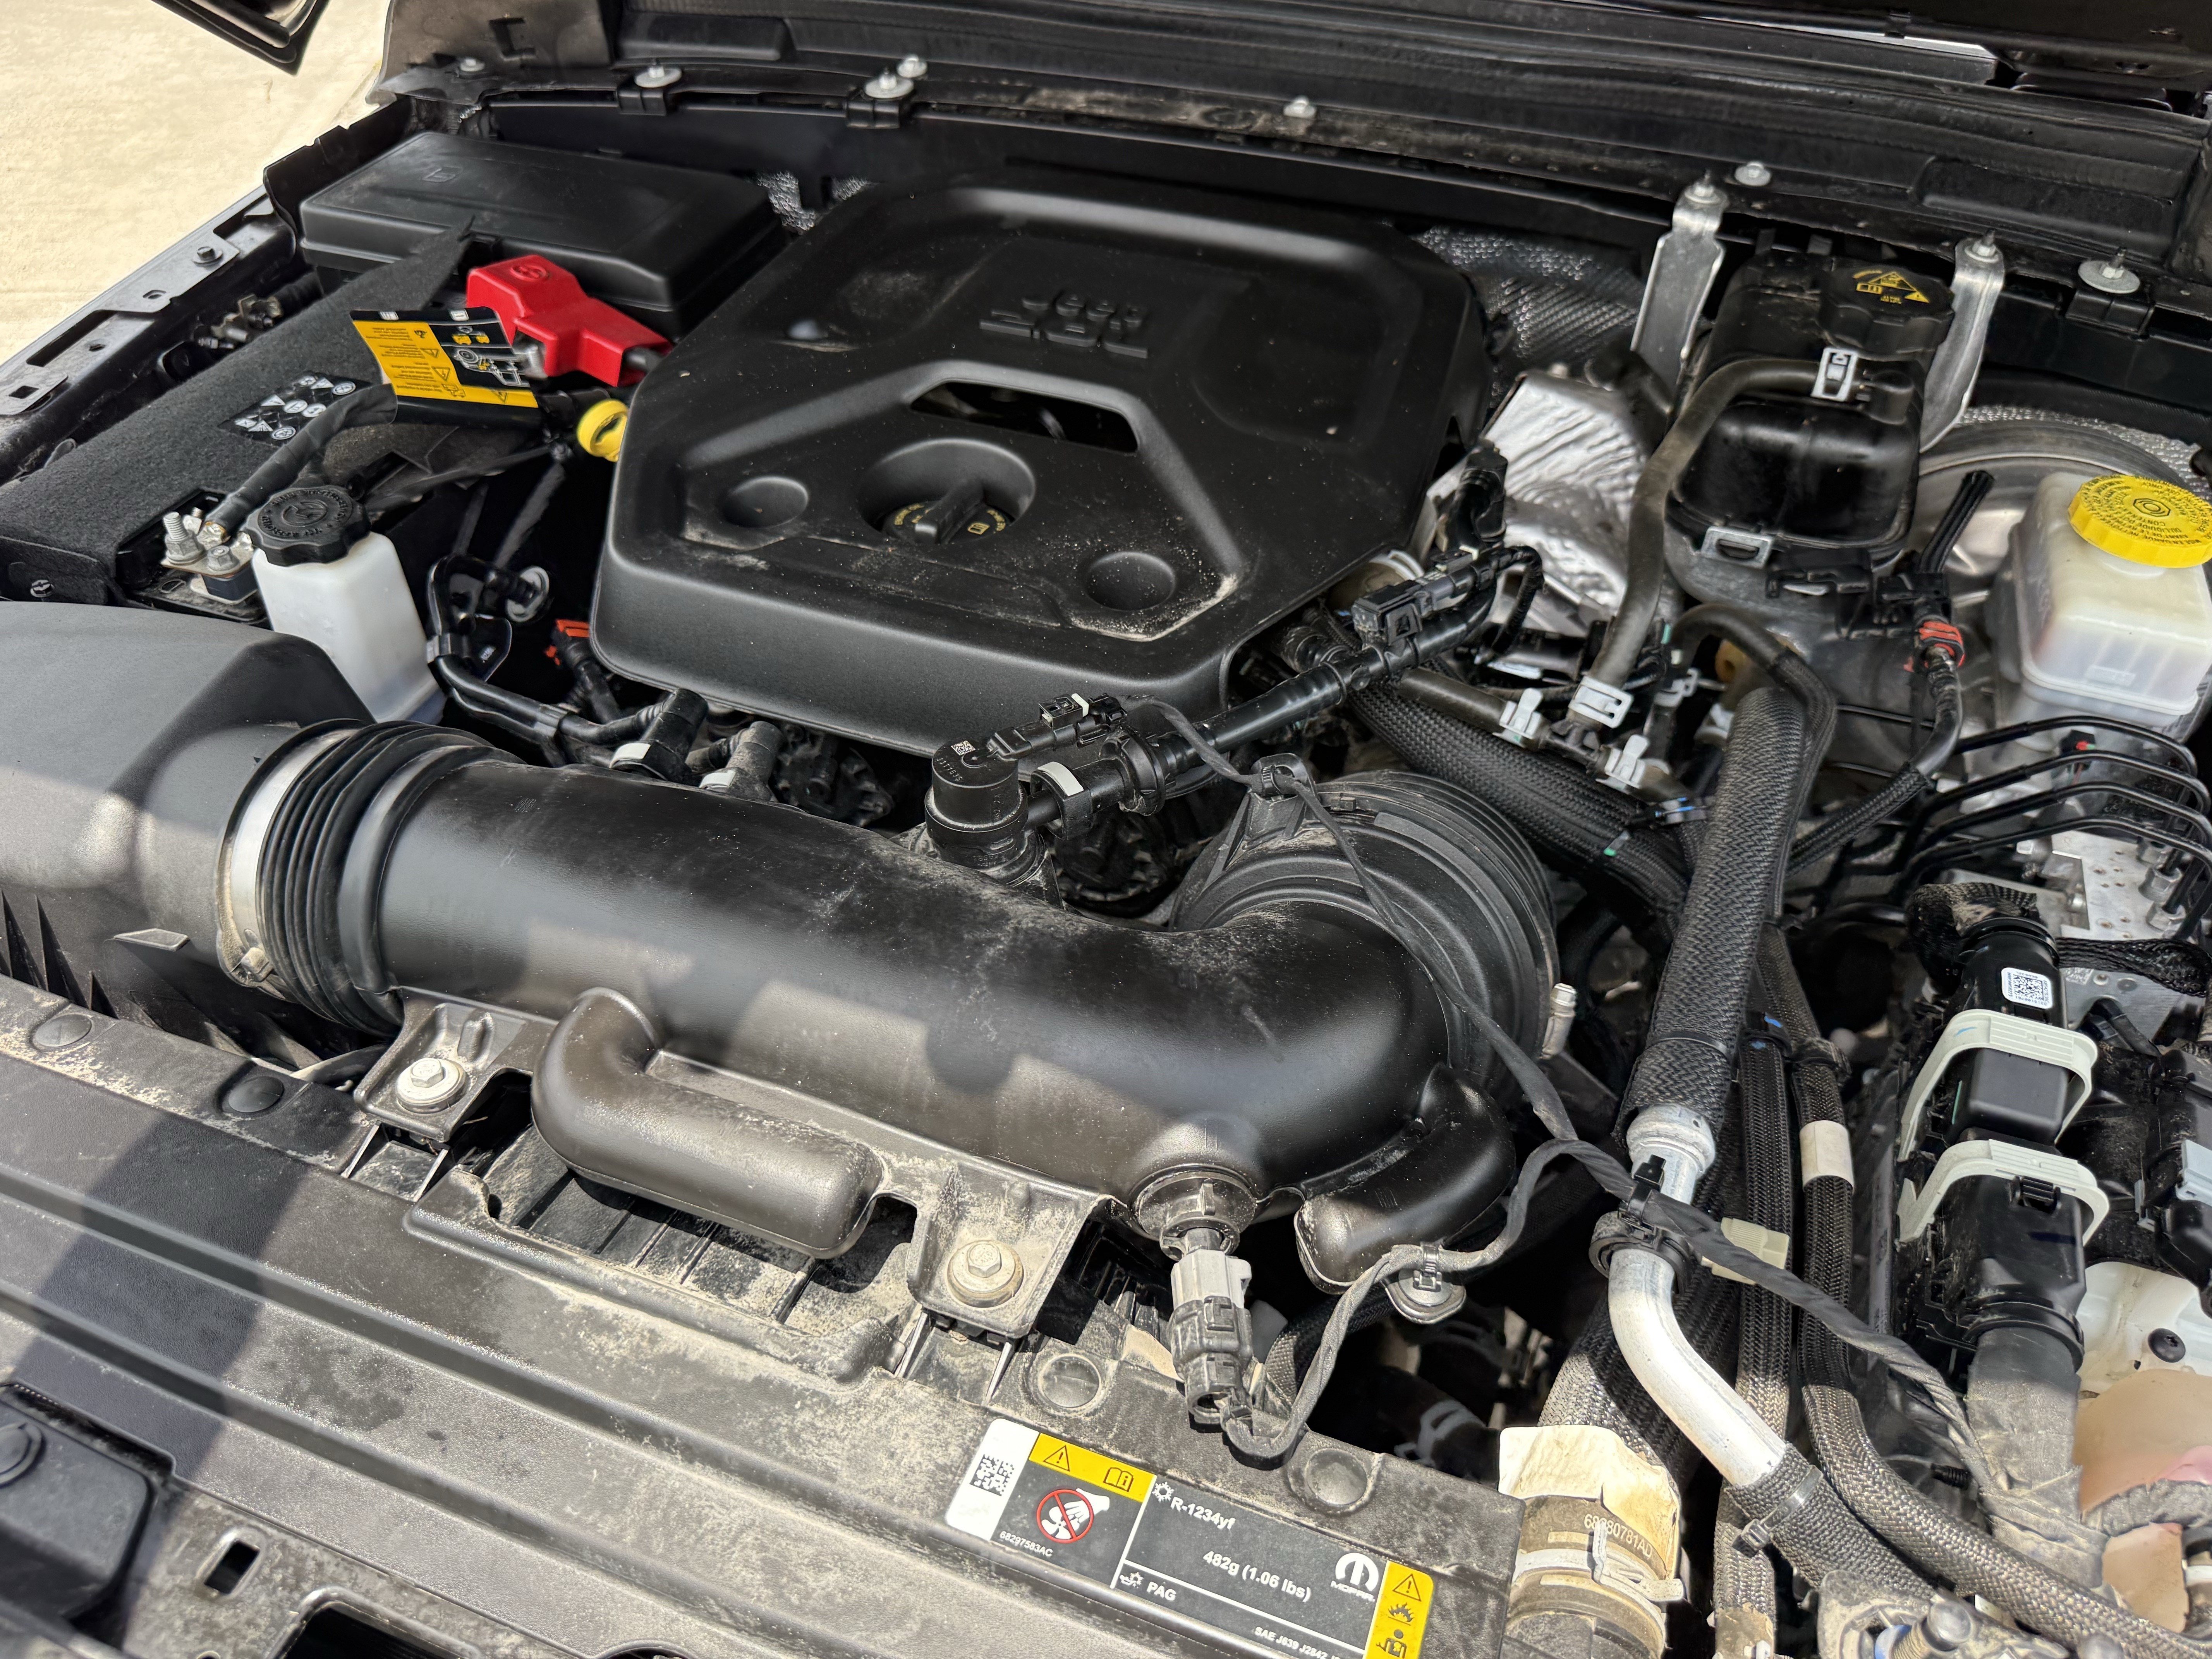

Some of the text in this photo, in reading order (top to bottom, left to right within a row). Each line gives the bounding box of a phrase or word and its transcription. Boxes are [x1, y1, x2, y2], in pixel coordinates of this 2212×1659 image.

[1170, 1496, 1236, 1530] R-1234yf
[1000, 1531, 1054, 1557] 68297583AC
[1584, 1513, 1653, 1558] 6880781AD
[1146, 1581, 1177, 1601] PAG
[1203, 1551, 1311, 1602] 482g (1.06 lbs)
[1254, 1626, 1277, 1641] SAE
